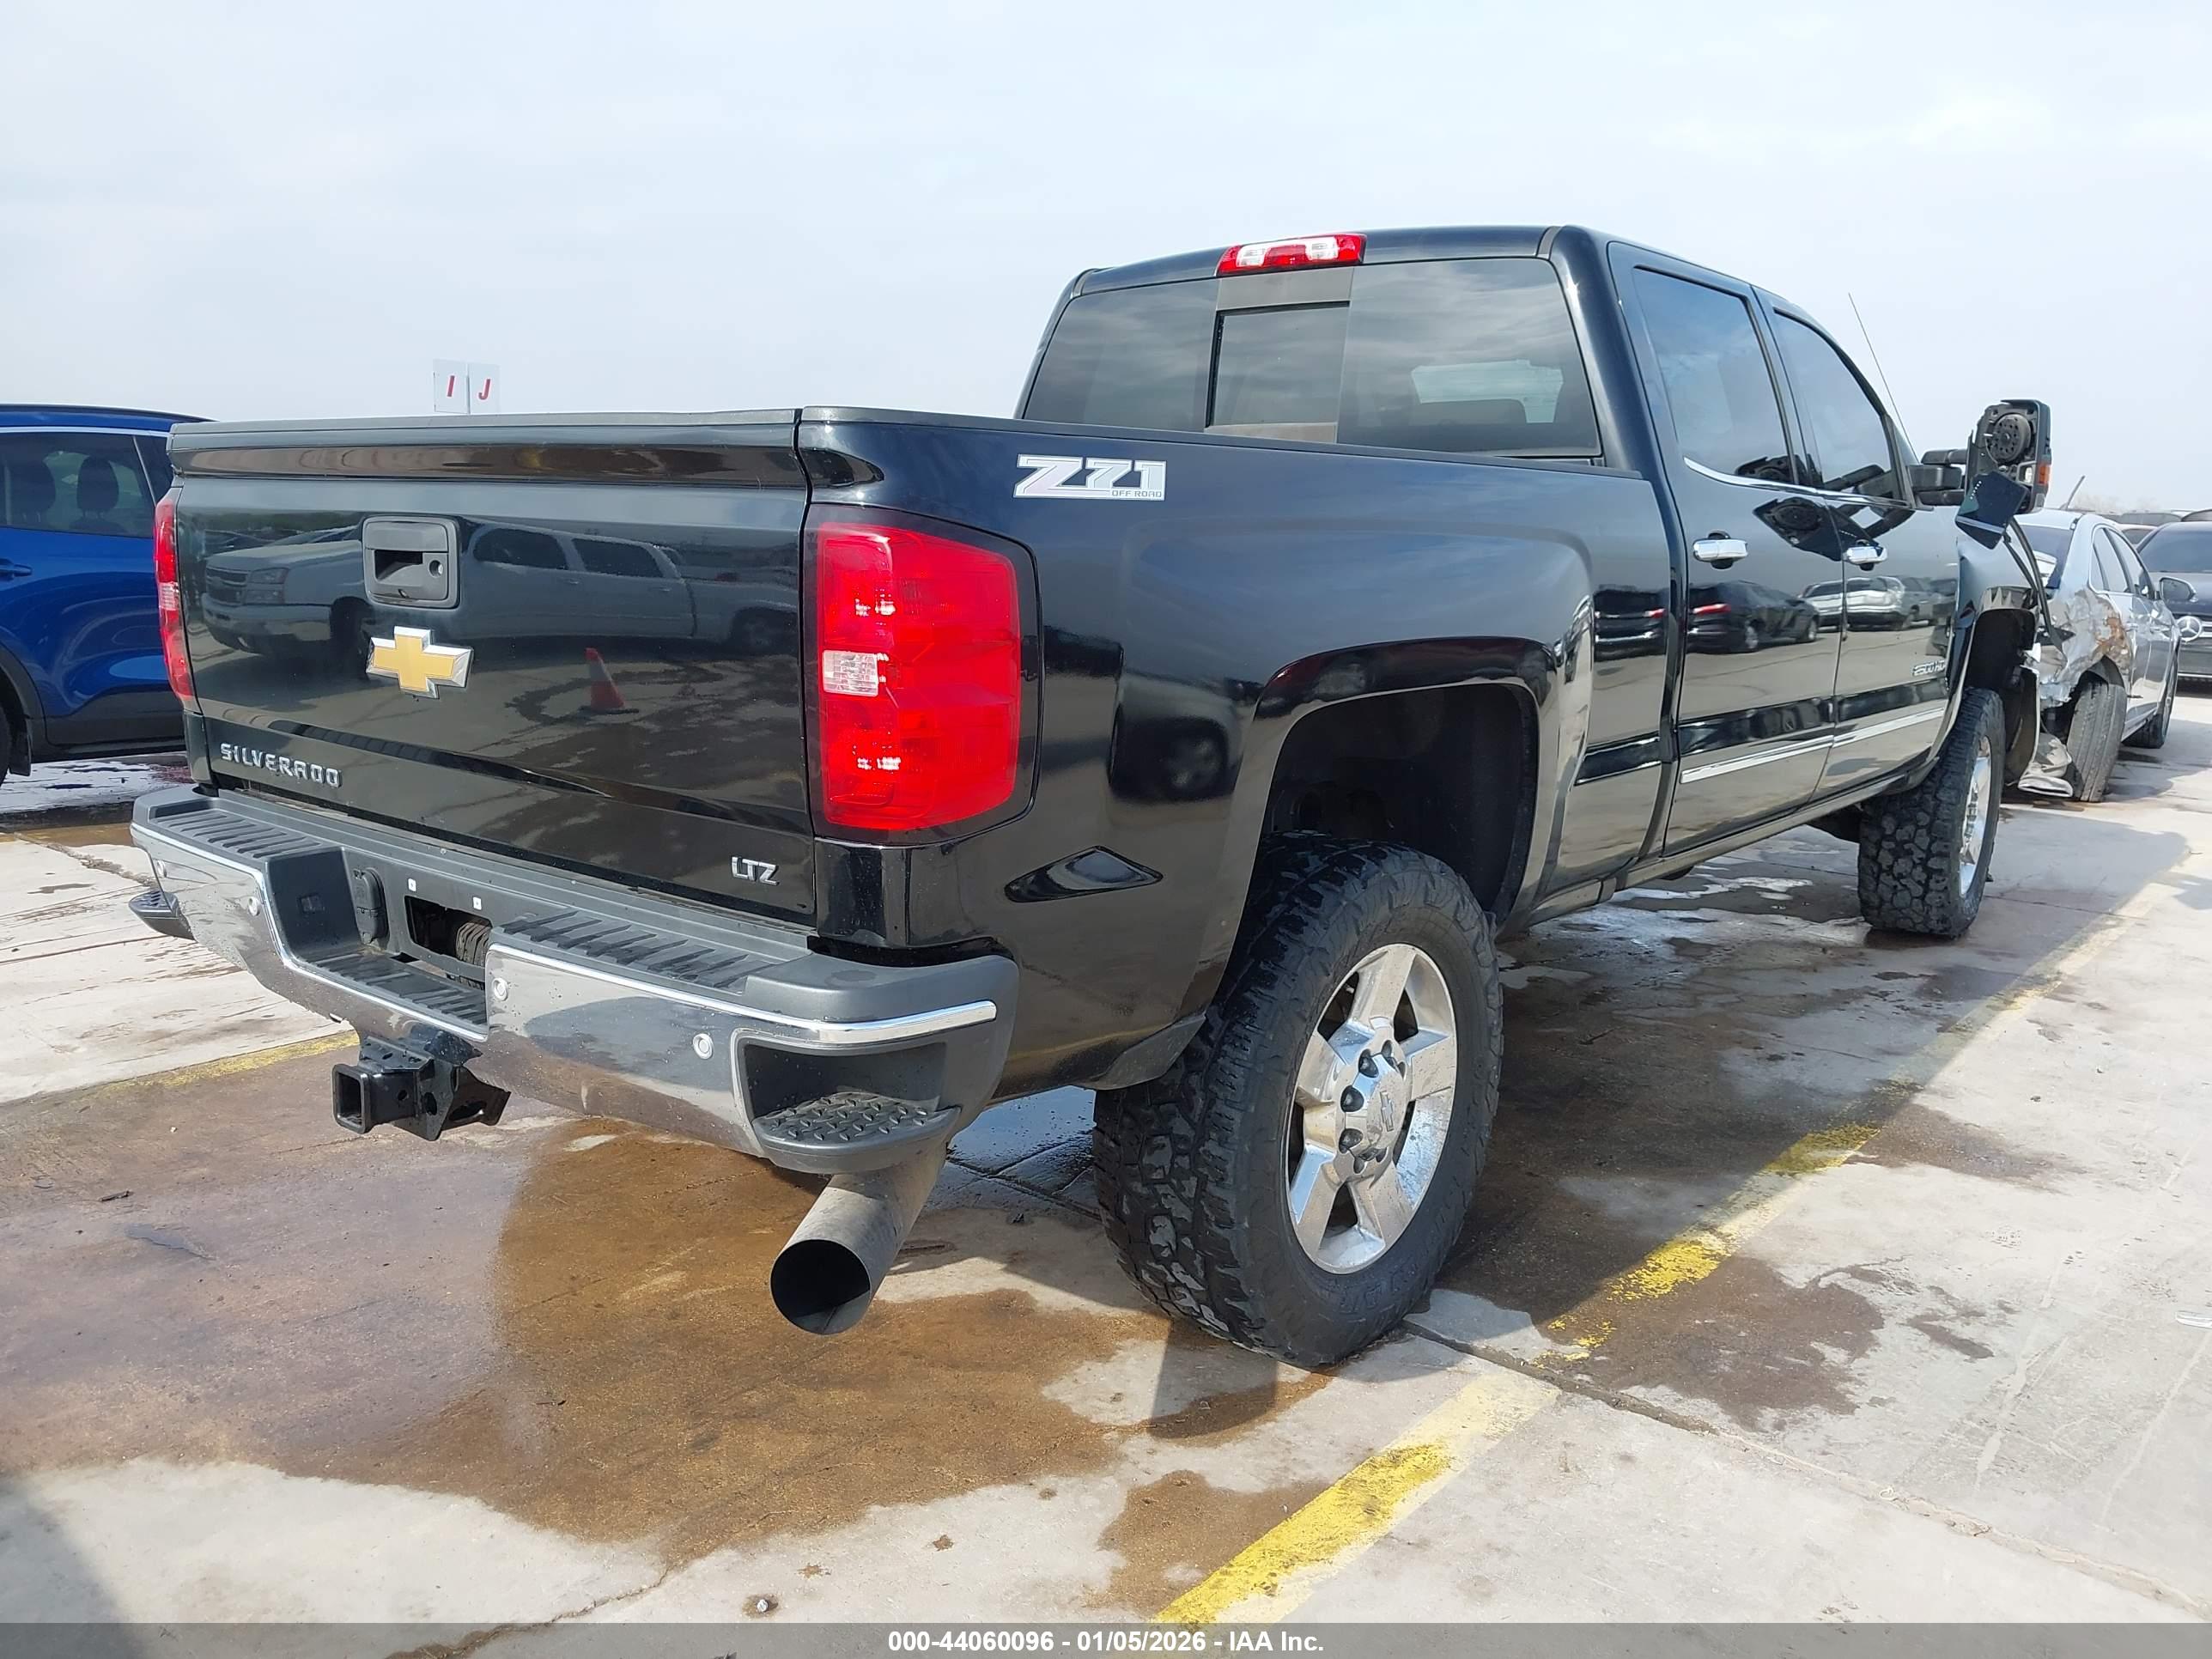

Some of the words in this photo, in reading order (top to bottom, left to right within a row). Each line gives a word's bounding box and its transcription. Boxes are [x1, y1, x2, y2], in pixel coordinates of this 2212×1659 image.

[447, 374, 455, 398] I
[478, 378, 491, 400] J
[1013, 453, 1167, 501] Z71
[220, 743, 342, 788] SILVERADO
[731, 856, 778, 886] LTZ
